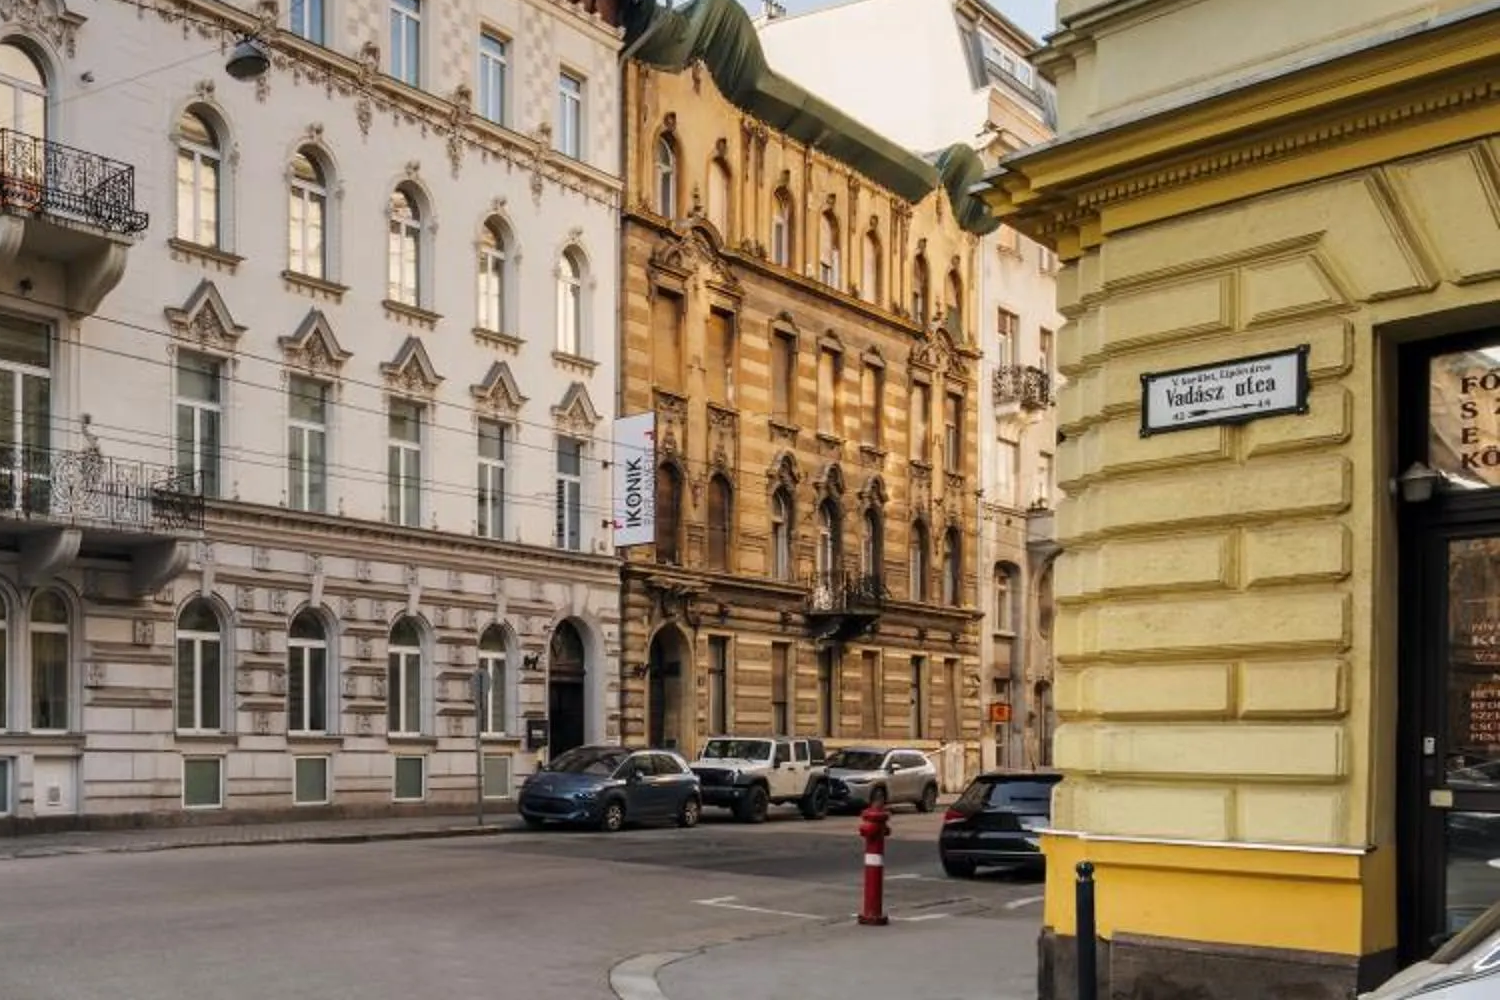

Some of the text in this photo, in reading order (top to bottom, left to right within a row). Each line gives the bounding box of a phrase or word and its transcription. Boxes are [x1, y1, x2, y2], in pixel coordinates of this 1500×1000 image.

[1166, 376, 1276, 408] Vadász utca
[625, 455, 642, 528] IKONIK
